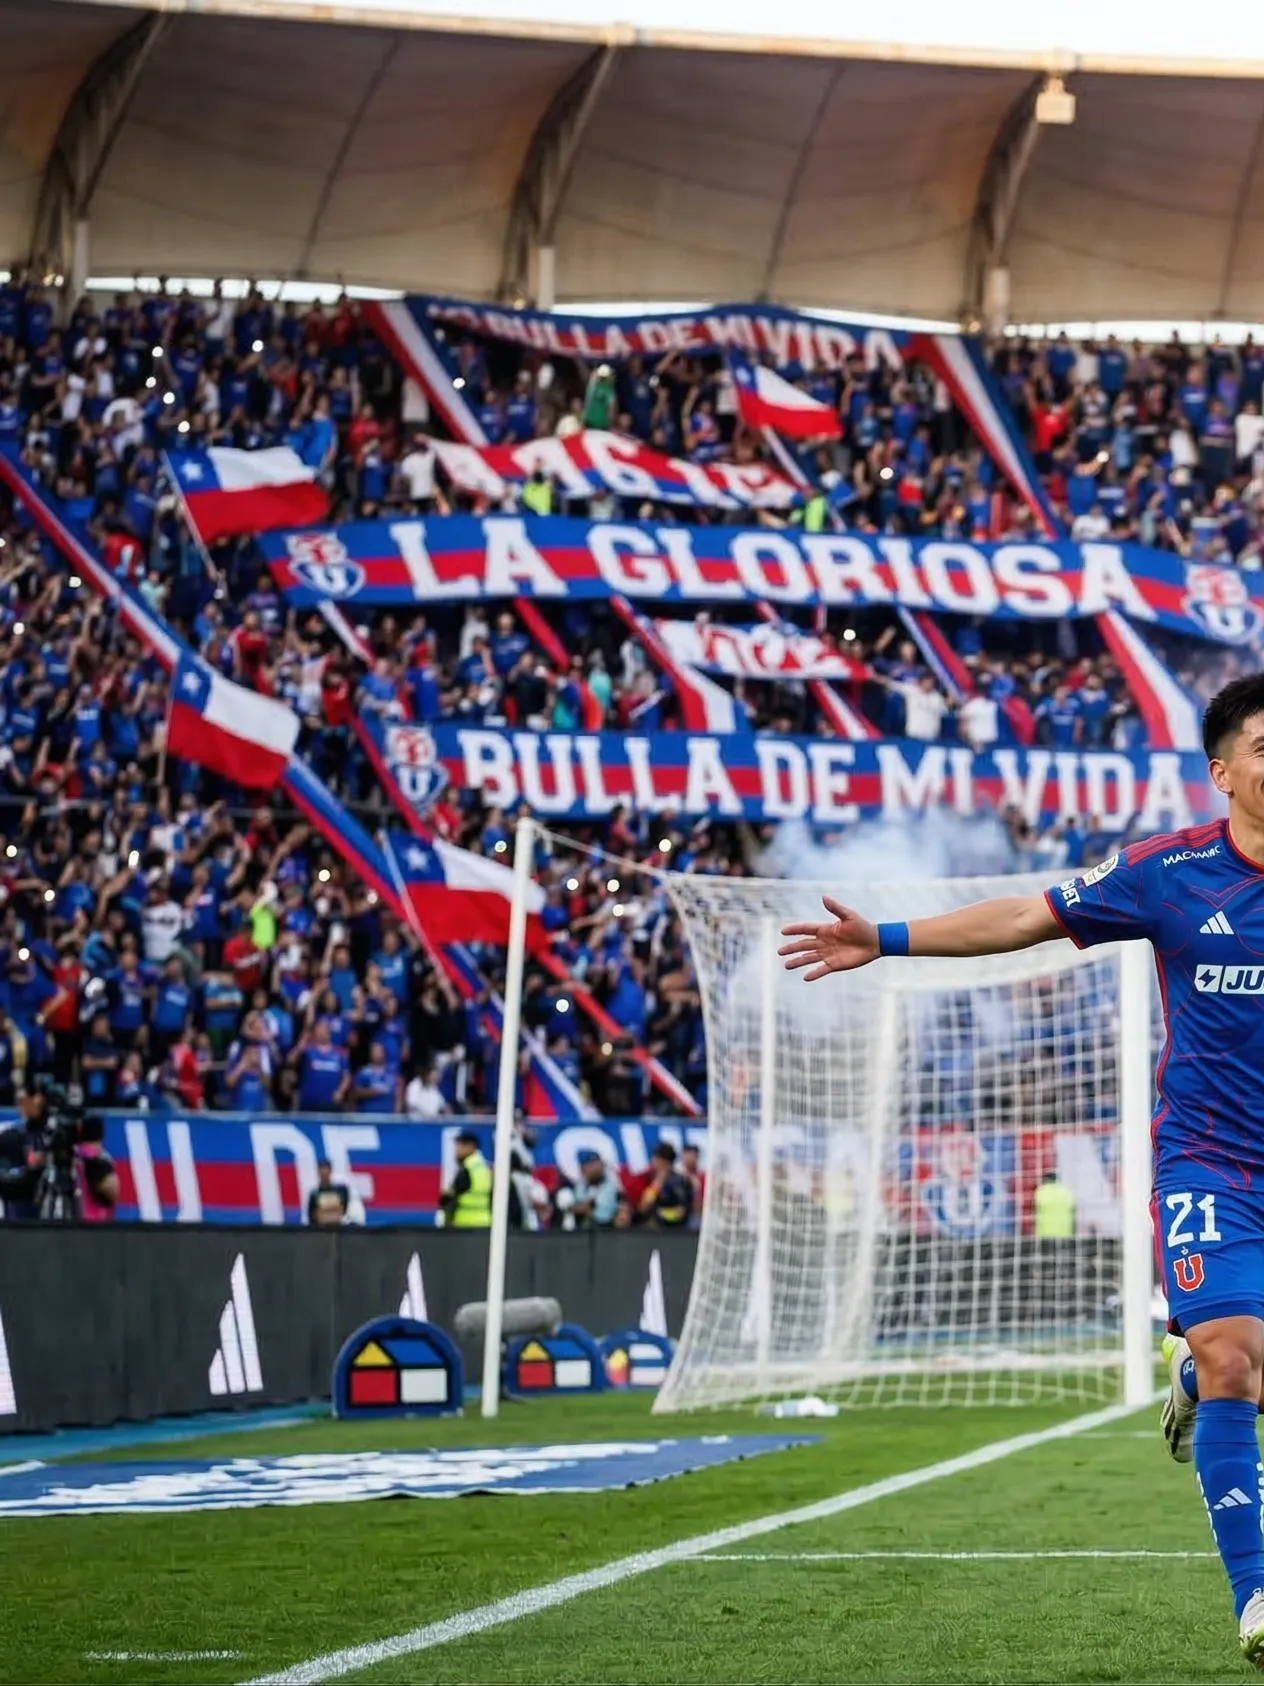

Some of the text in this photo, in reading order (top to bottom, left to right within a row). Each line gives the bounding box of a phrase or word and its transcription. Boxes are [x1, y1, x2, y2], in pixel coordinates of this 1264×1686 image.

[389, 517, 1158, 622] LA GLORIOSA
[456, 729, 1195, 834] BULLA DE MI VIDA
[1165, 1192, 1222, 1248] 21
[1173, 1253, 1205, 1292] U
